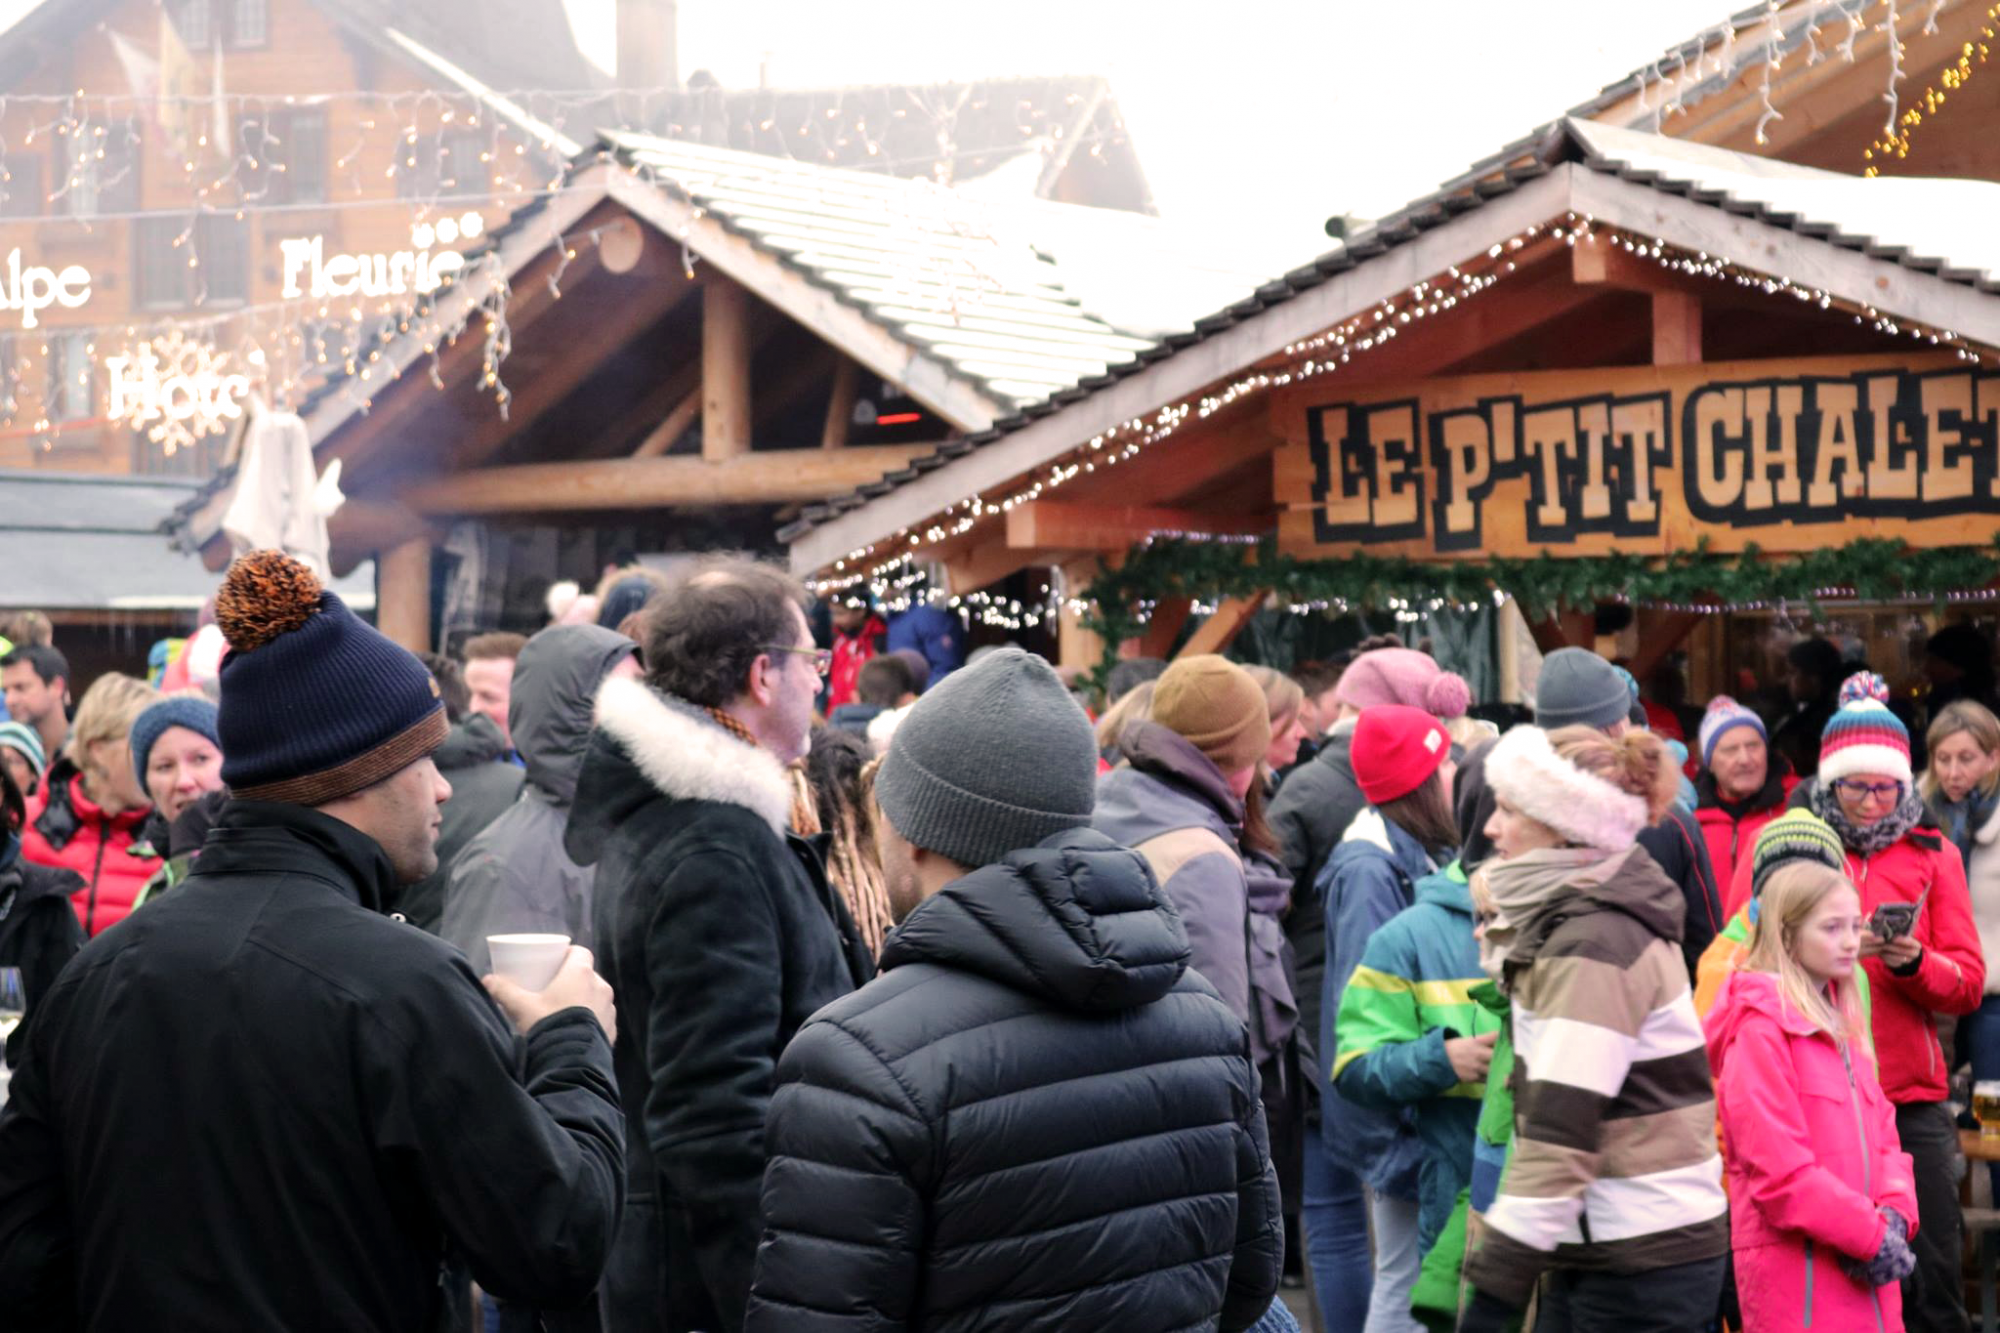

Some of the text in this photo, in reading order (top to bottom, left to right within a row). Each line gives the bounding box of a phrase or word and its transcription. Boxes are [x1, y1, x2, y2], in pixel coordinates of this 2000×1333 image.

[280, 234, 465, 299] Fleurie
[1321, 404, 1418, 528] LE
[1442, 399, 1666, 533] P'TIT
